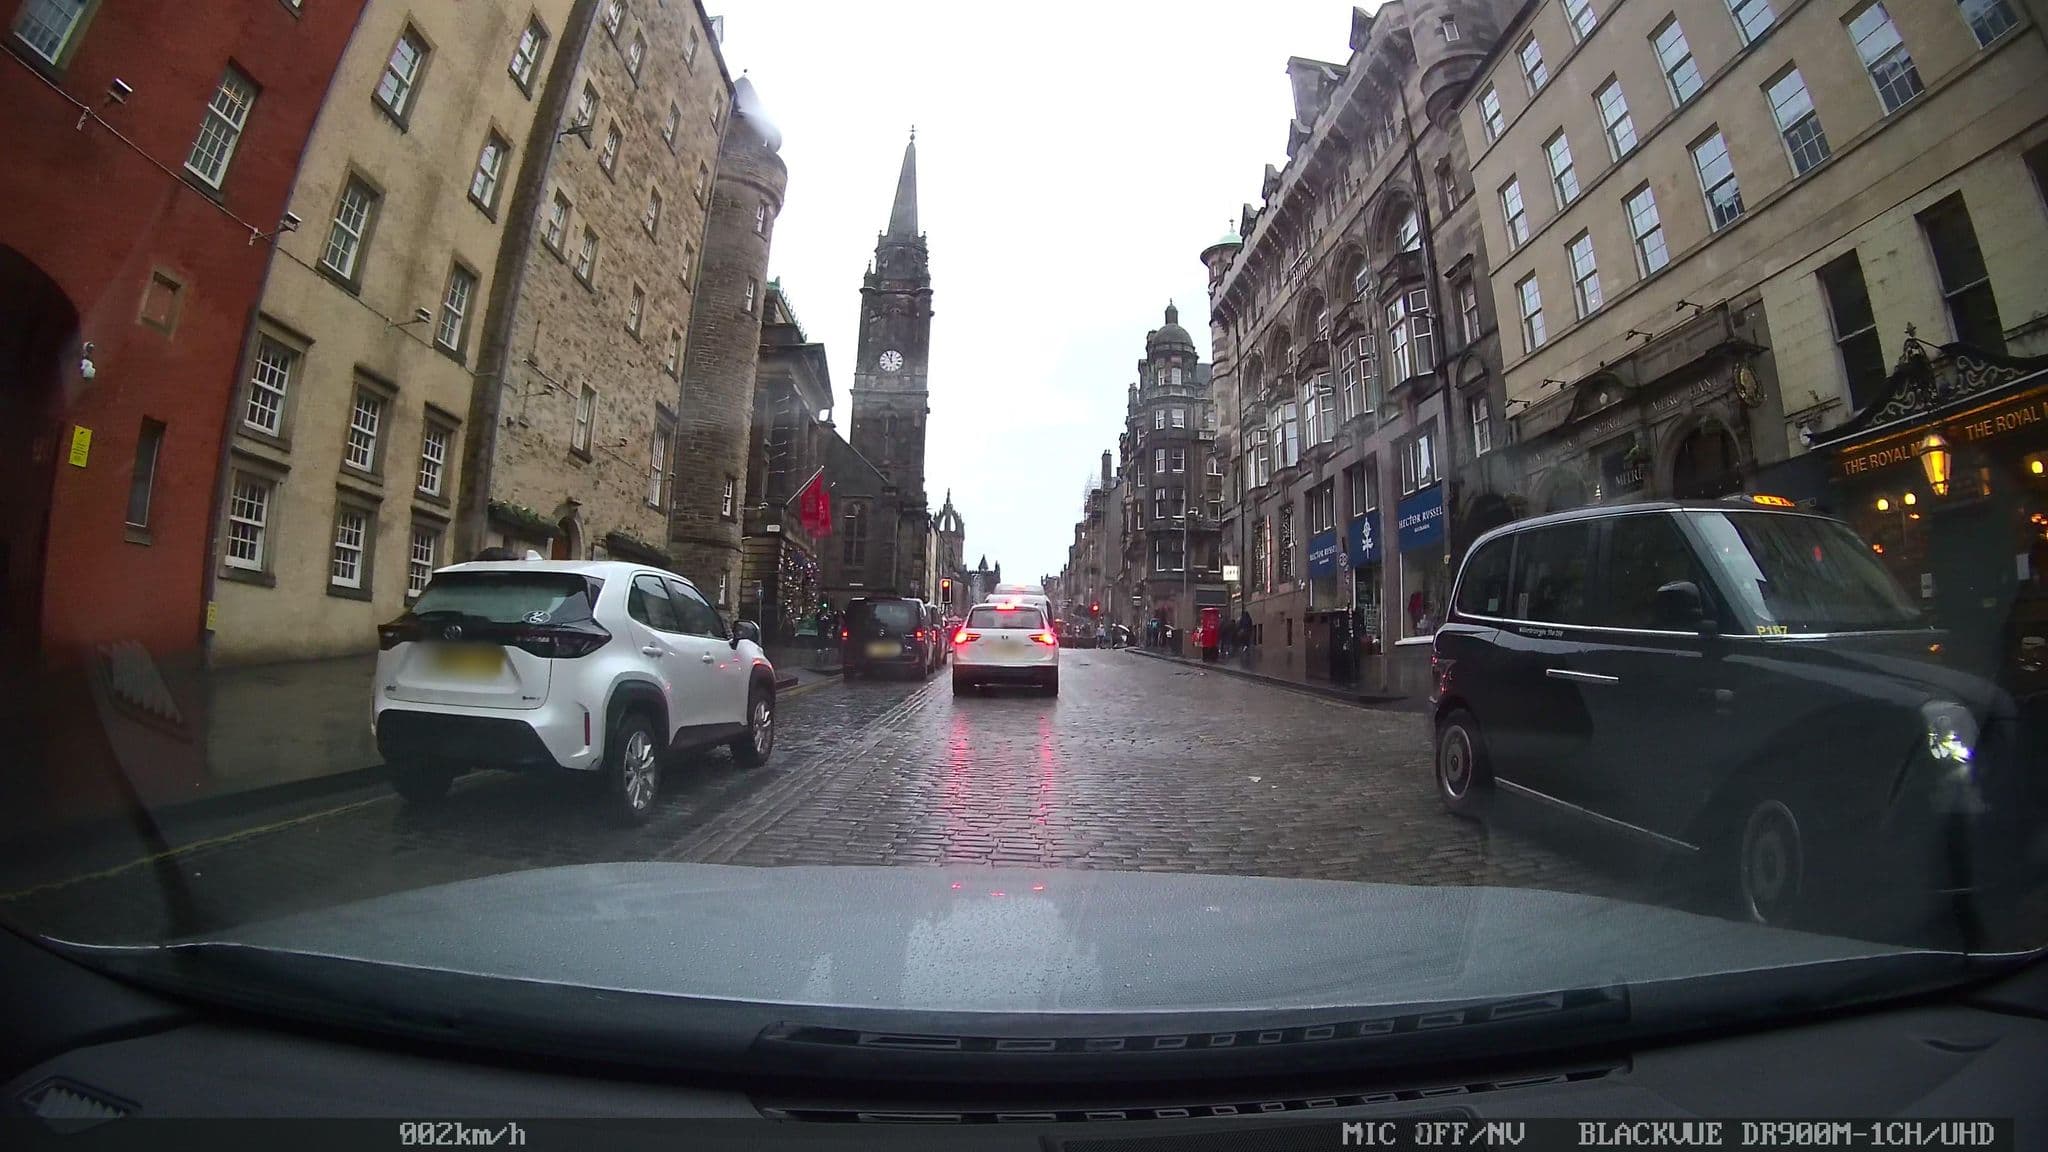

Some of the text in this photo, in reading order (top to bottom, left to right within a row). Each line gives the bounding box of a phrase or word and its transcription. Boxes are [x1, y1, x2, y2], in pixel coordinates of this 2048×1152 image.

[1293, 255, 1314, 286] Hilton
[1965, 420, 1994, 440] THE
[1996, 406, 2040, 431] ROYAL
[1844, 457, 1868, 475] THE
[1869, 446, 1911, 468] ROYAL
[1399, 514, 1421, 529] HECTOR
